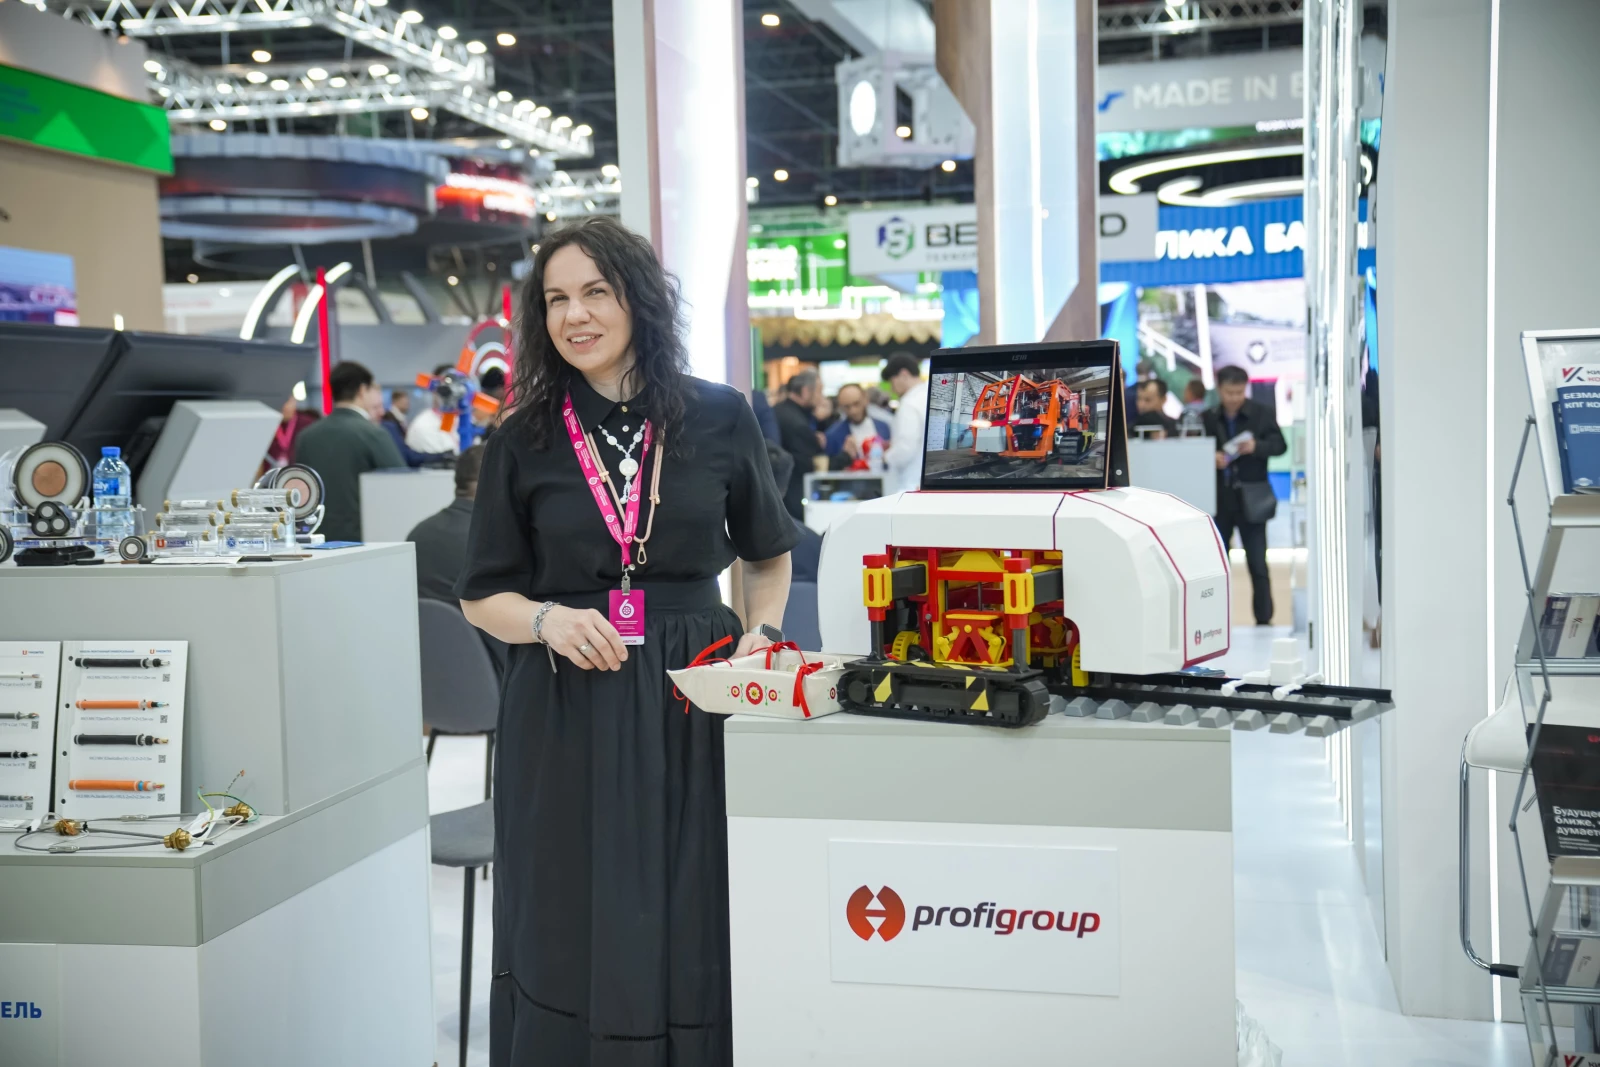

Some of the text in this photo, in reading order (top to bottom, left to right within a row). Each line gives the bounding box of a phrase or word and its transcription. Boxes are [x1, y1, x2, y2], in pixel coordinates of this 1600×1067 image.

[1133, 77, 1232, 109] MADE
[1244, 74, 1277, 101] IN
[1555, 815, 1596, 828] ближе,
[1556, 826, 1600, 837] думает
[912, 902, 1101, 938] profigroup
[1, 1001, 42, 1019] ЕЛЬ
